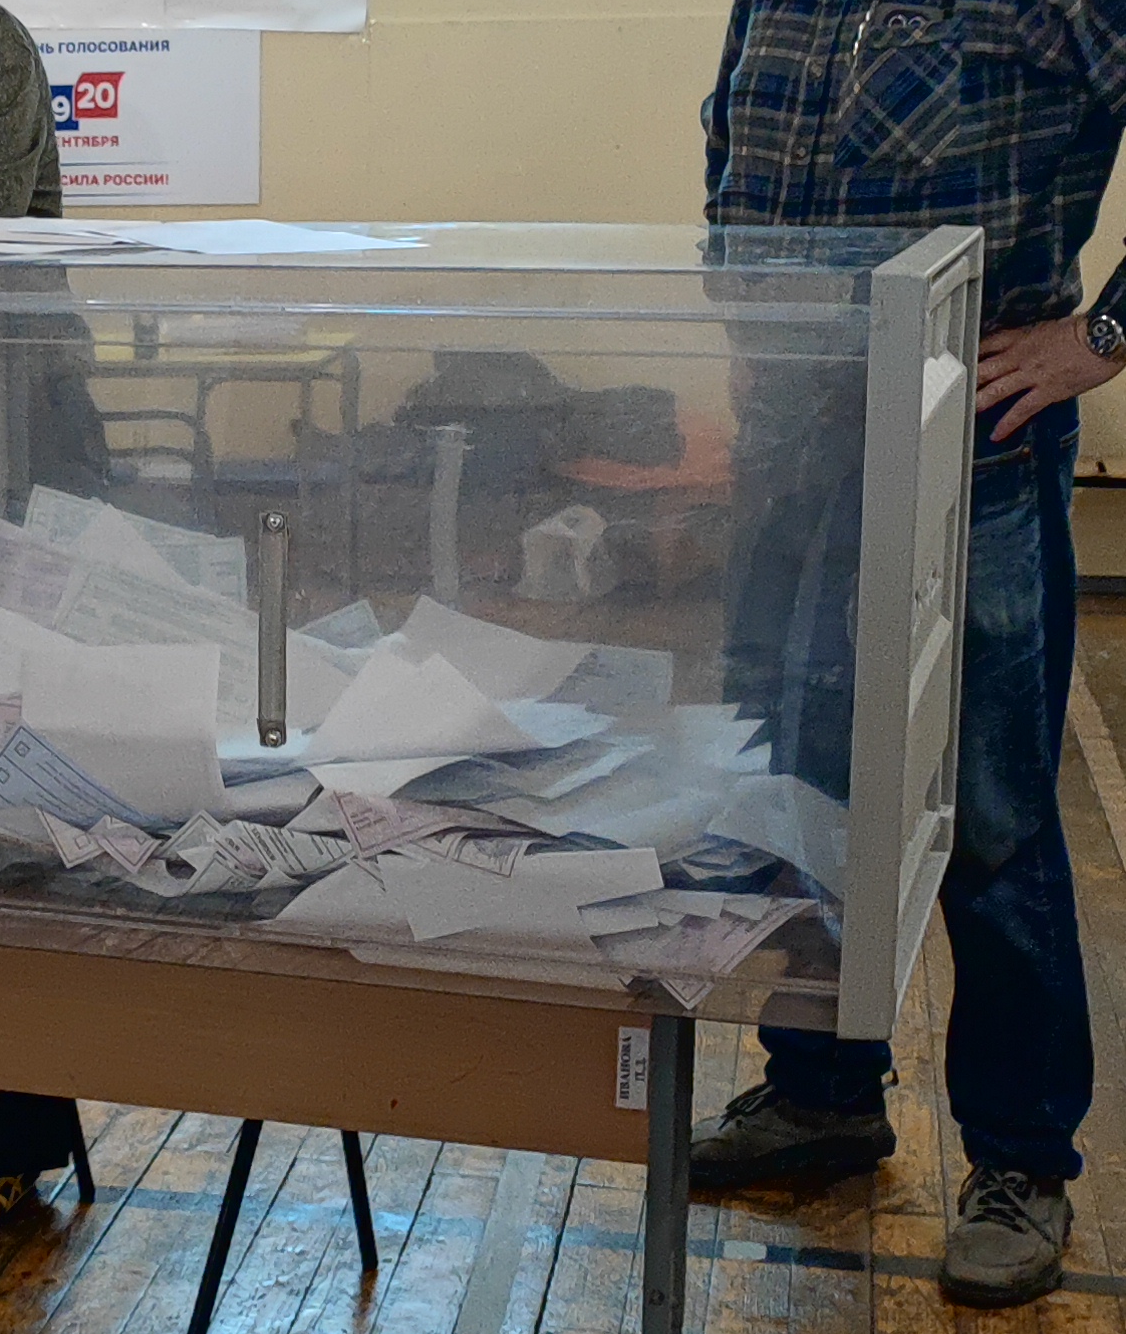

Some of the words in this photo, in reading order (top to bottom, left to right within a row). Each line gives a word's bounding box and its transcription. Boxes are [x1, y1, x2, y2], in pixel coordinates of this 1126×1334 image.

[38, 42, 54, 54] НЬ
[58, 40, 170, 54] ГОЛОСОВАНИЯ
[51, 95, 71, 122] 9
[77, 81, 115, 109] 20
[57, 135, 119, 147] НТЯБРЯ
[61, 174, 100, 186] СИЛА
[103, 173, 169, 186] РОССИИ!
